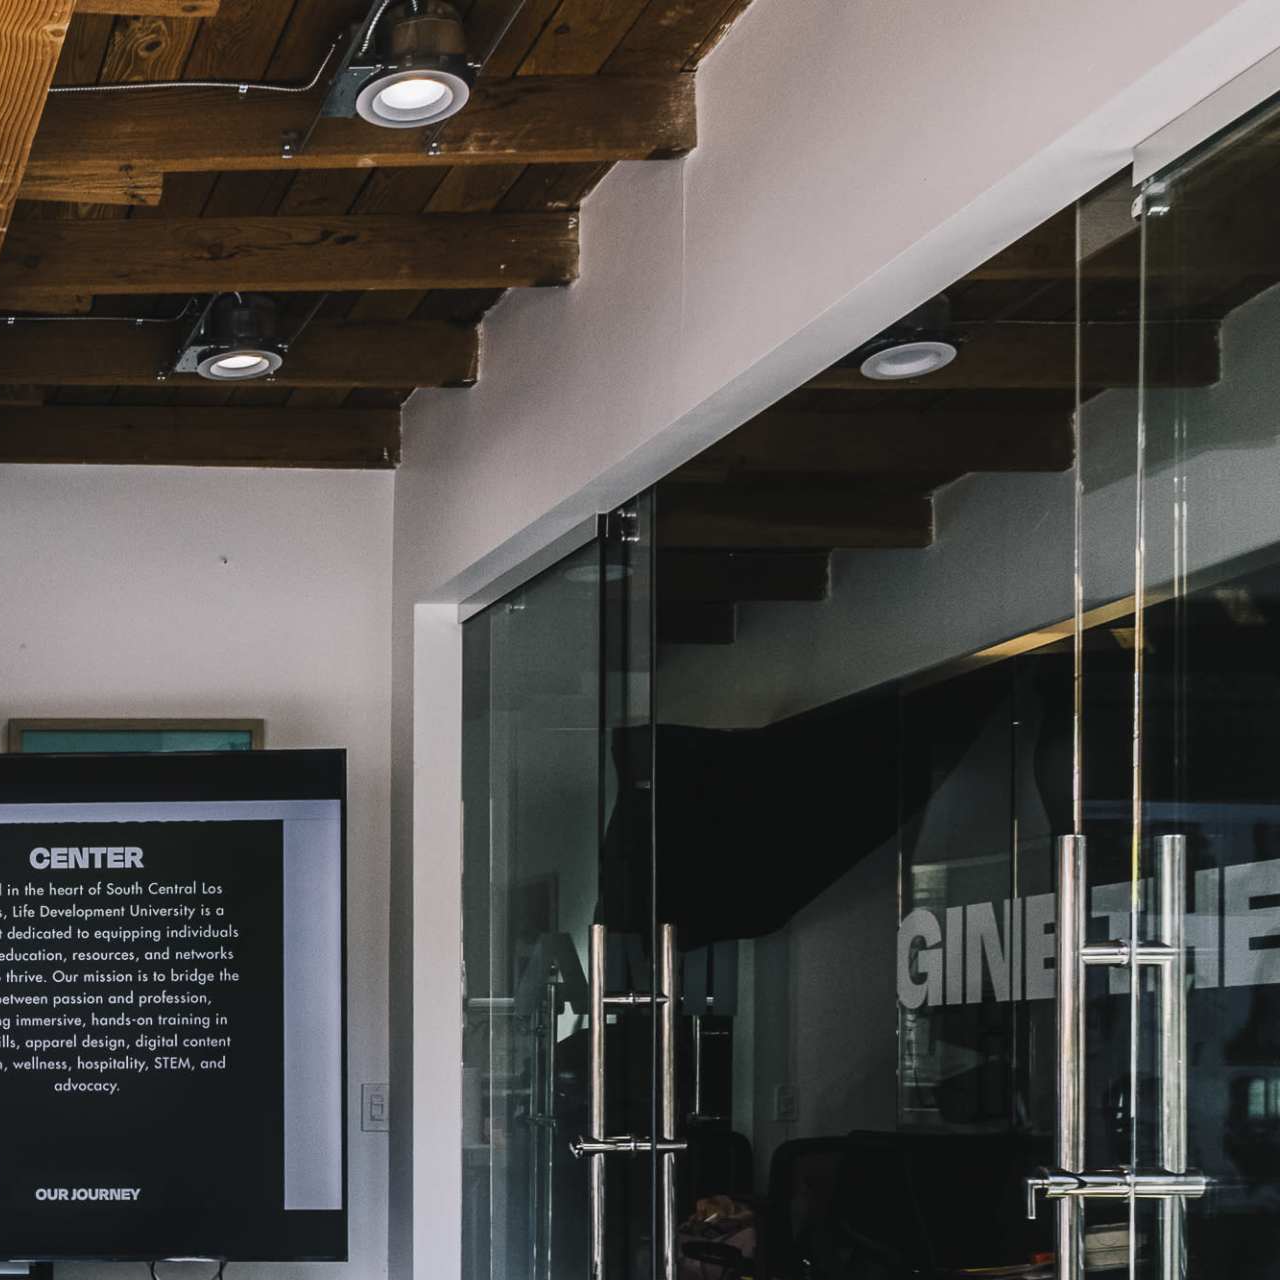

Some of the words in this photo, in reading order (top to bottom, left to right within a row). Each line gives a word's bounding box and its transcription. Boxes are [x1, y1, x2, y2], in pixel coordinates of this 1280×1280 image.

[29, 846, 144, 869] CENTER
[7, 884, 19, 896] in
[24, 882, 44, 896] the
[49, 882, 84, 896] heart
[88, 881, 102, 896] of
[106, 881, 143, 895] South
[148, 880, 196, 895] Central
[202, 882, 222, 894] Los
[12, 903, 35, 918] Life
[39, 903, 125, 920] Development
[130, 904, 196, 920] University
[200, 904, 210, 916] is
[215, 907, 224, 916] a
[6, 925, 72, 940] dedicated
[77, 928, 90, 939] to
[94, 926, 161, 942] equipping
[166, 923, 239, 938] individuals
[72, 951, 139, 962] resources,
[144, 946, 170, 960] and
[175, 945, 234, 960] networks
[6, 969, 47, 983] thrive.
[52, 969, 79, 983] Our
[83, 970, 132, 983] mission
[138, 969, 148, 982] is
[152, 971, 166, 982] to
[170, 967, 214, 985] bridge
[219, 967, 239, 981] the
[52, 991, 103, 1008] passion
[108, 989, 134, 1004] and
[138, 989, 211, 1007] profession,
[16, 1013, 86, 1028] immersive,
[91, 1012, 153, 1026] hands-on
[158, 1013, 210, 1029] training
[215, 1012, 228, 1025] in
[24, 1033, 77, 1051] apparel
[81, 1033, 130, 1051] design,
[135, 1033, 178, 1051] digital
[182, 1036, 231, 1047] content
[12, 1055, 72, 1071] wellness,
[77, 1055, 149, 1073] hospitality,
[154, 1056, 195, 1071] STEM,
[200, 1055, 226, 1069] and
[54, 1078, 120, 1095] advocacy.
[35, 1188, 69, 1201] OUR
[70, 1188, 140, 1201] JOURNEY
